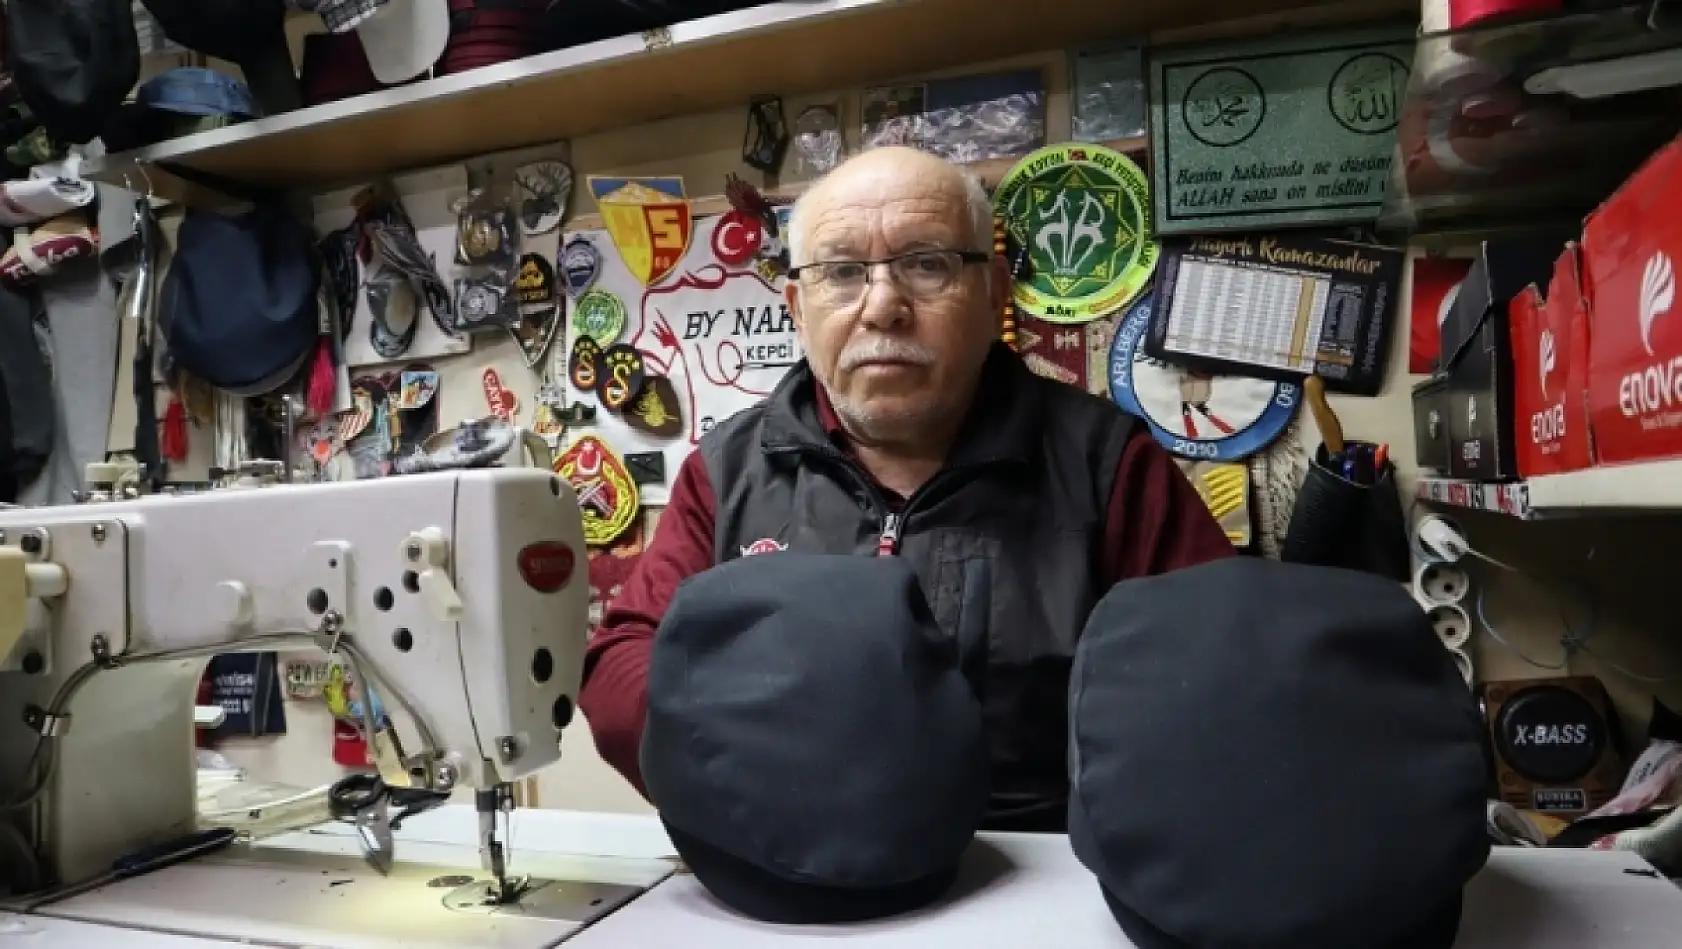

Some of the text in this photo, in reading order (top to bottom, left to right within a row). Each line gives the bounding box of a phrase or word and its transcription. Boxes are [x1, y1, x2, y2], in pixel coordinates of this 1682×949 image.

[1312, 161, 1332, 176] ne
[1176, 186, 1236, 208] ALLAH
[1241, 187, 1279, 204] sana
[1287, 184, 1307, 201] on
[683, 309, 726, 340] BY
[1112, 306, 1150, 388] ARLBERG
[1513, 723, 1587, 746] X-BASS
